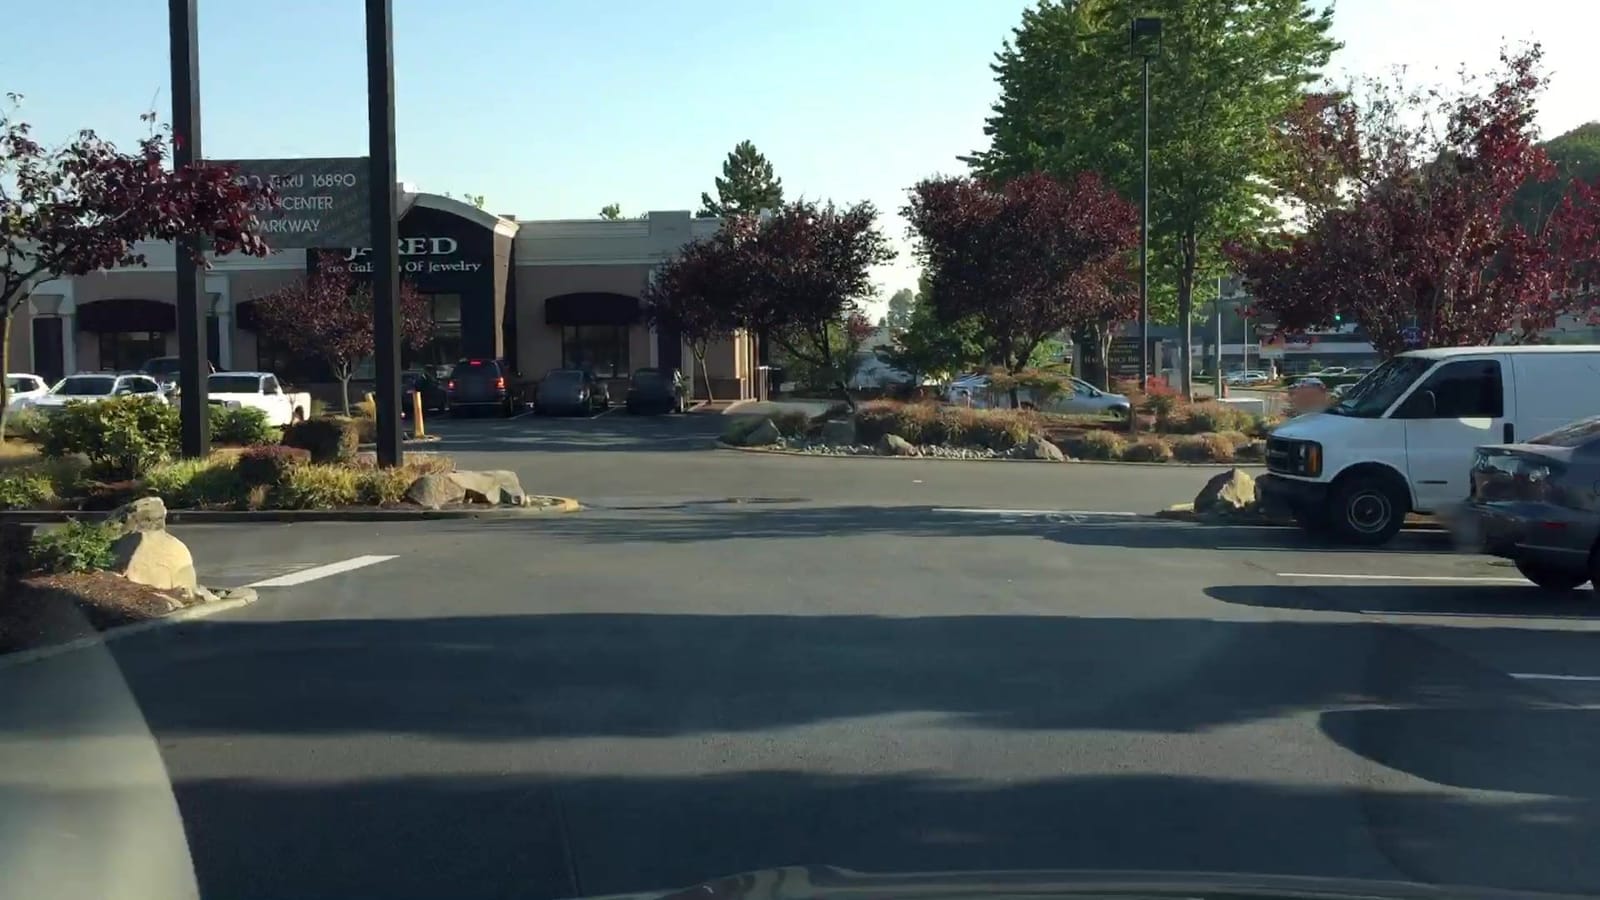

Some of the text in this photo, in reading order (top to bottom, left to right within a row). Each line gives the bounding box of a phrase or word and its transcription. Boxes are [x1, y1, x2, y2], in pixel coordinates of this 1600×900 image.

[311, 173, 356, 187] 16890
[248, 218, 321, 233] ARKWAY
[428, 259, 482, 273] Jewelry
